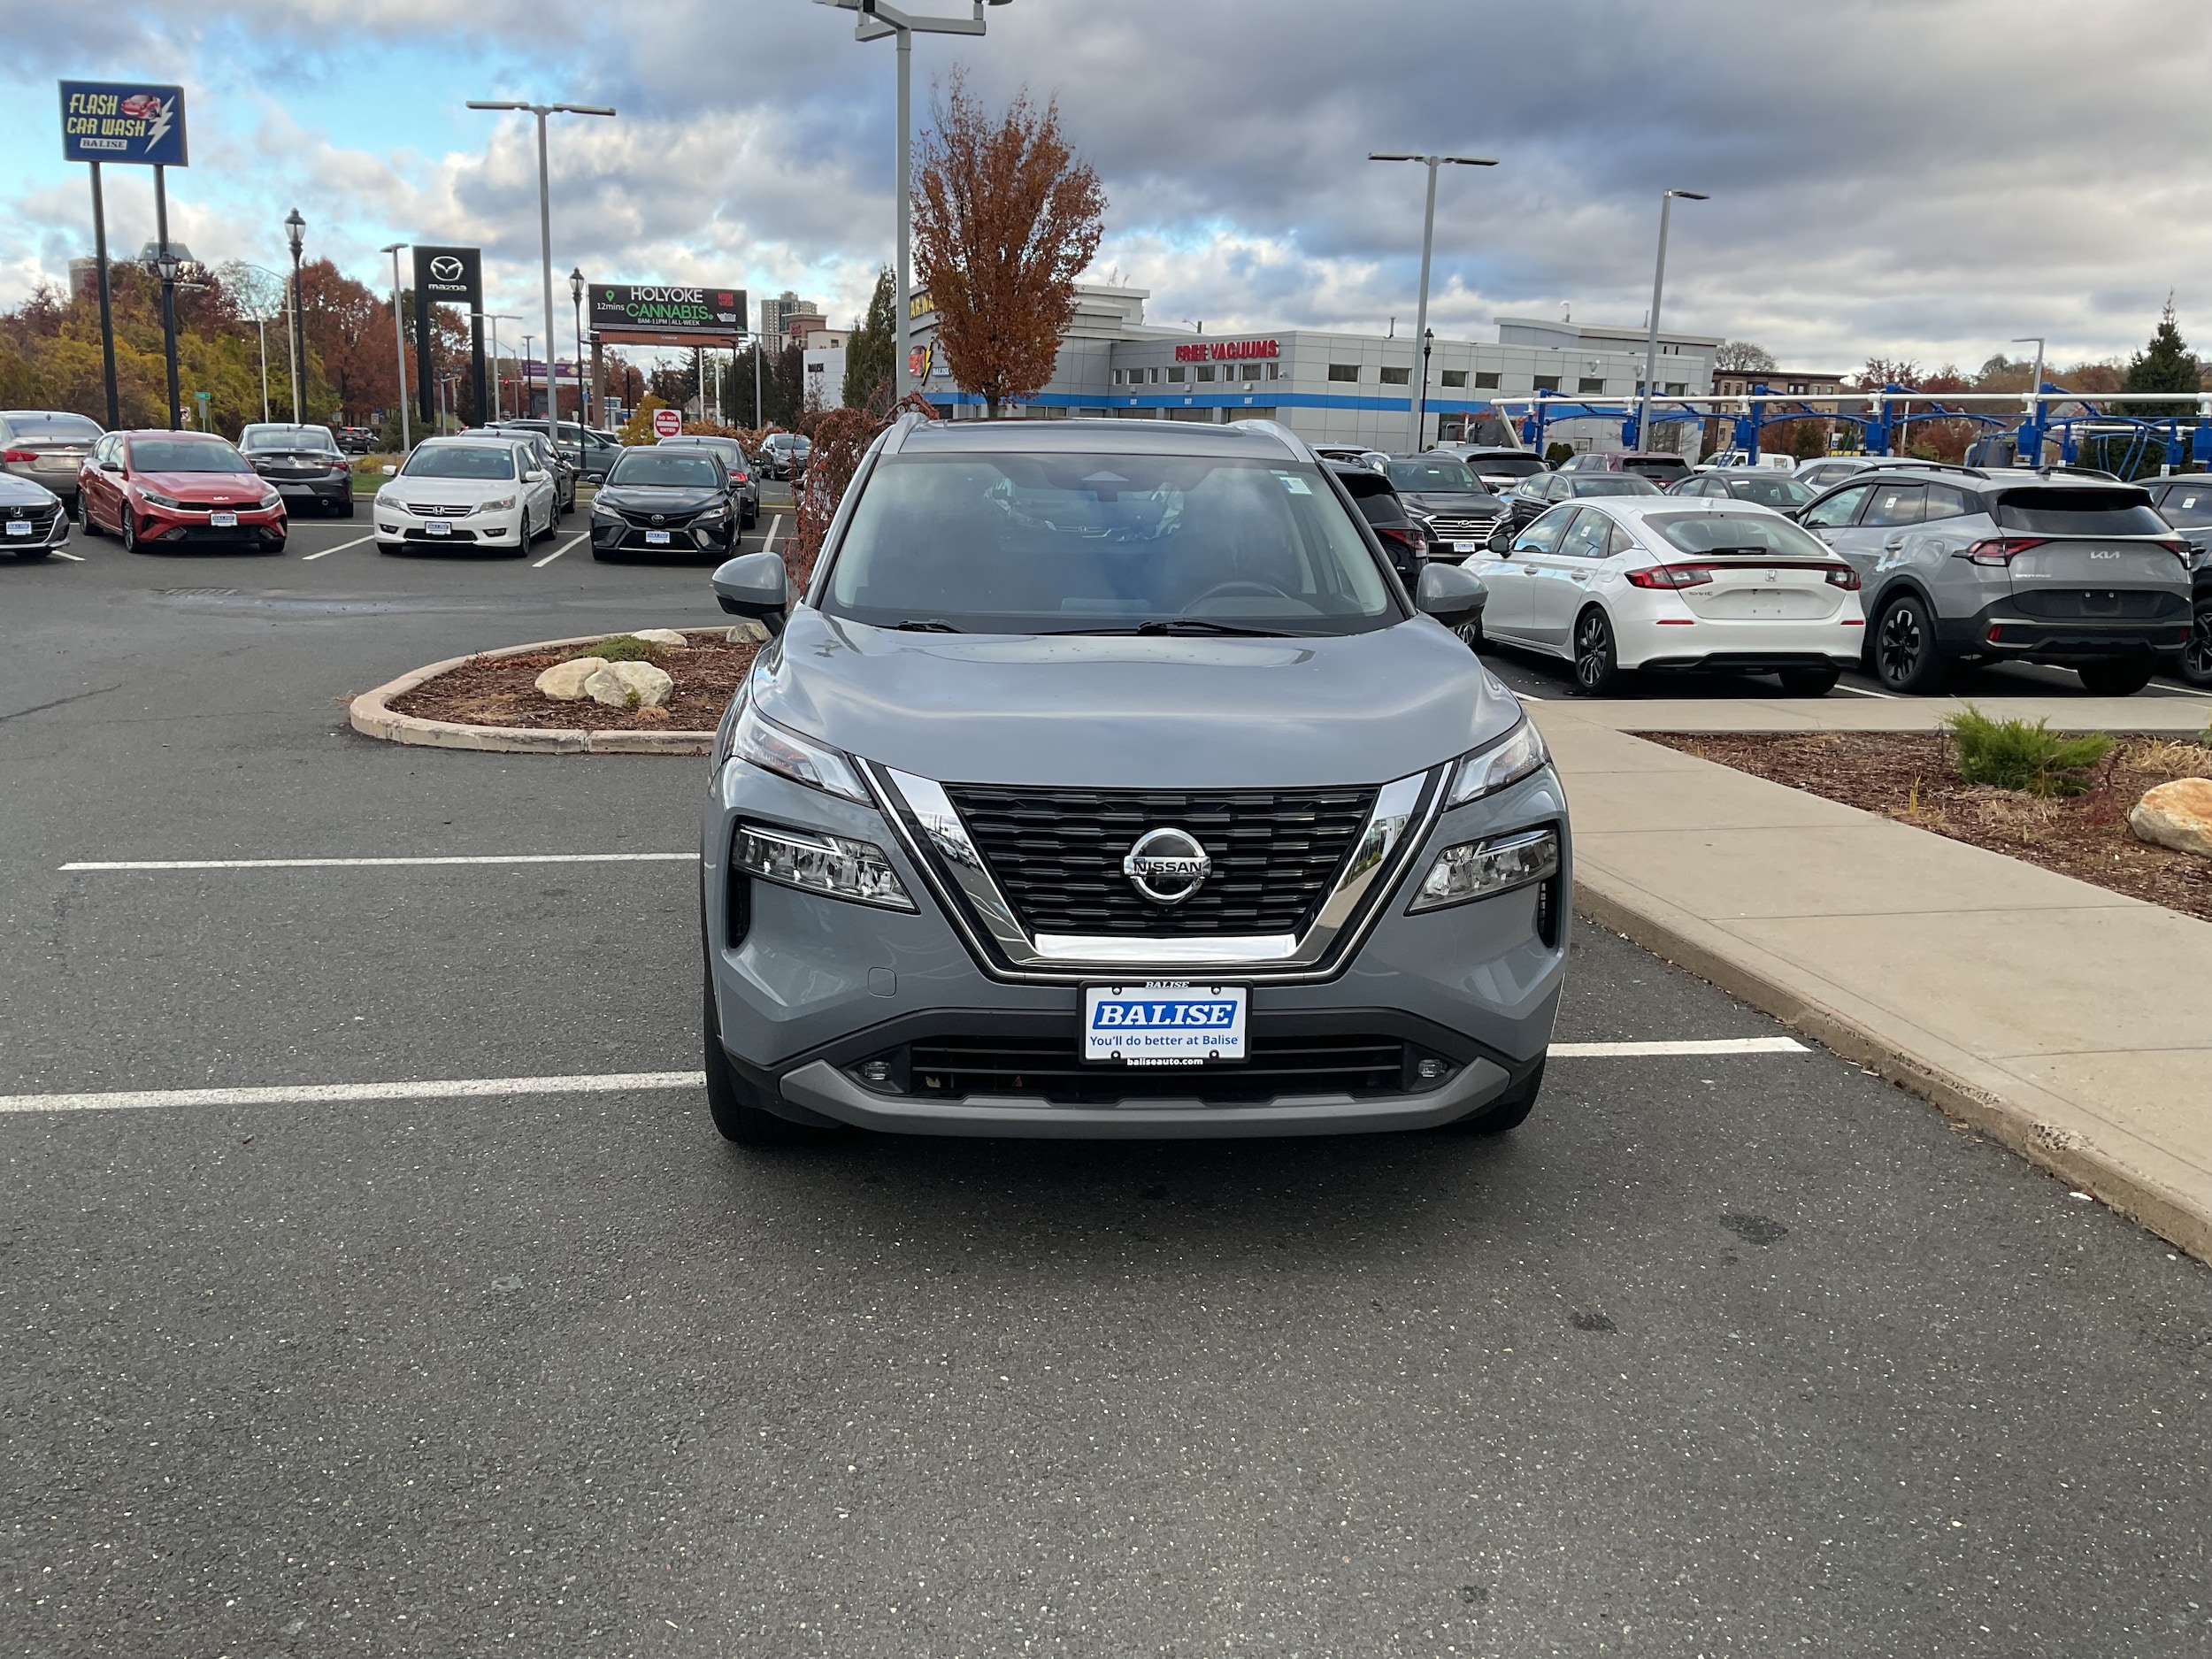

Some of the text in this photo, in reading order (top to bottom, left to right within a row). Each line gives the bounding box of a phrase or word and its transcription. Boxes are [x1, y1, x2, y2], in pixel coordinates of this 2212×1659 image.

[69, 93, 118, 115] FLASH
[66, 117, 145, 136] CAR WASH
[81, 139, 126, 149] BALISE
[631, 286, 703, 303] HOLYOKE
[596, 302, 625, 311] 12mins
[1175, 340, 1279, 362] FREE VACUUMS
[2090, 550, 2121, 559] KIA
[1133, 861, 1202, 872] NISSAN
[1097, 1004, 1233, 1025] BALISE
[1090, 1034, 1239, 1046] You'll do better at Balise
[1126, 1057, 1204, 1066] baliseauto.com
